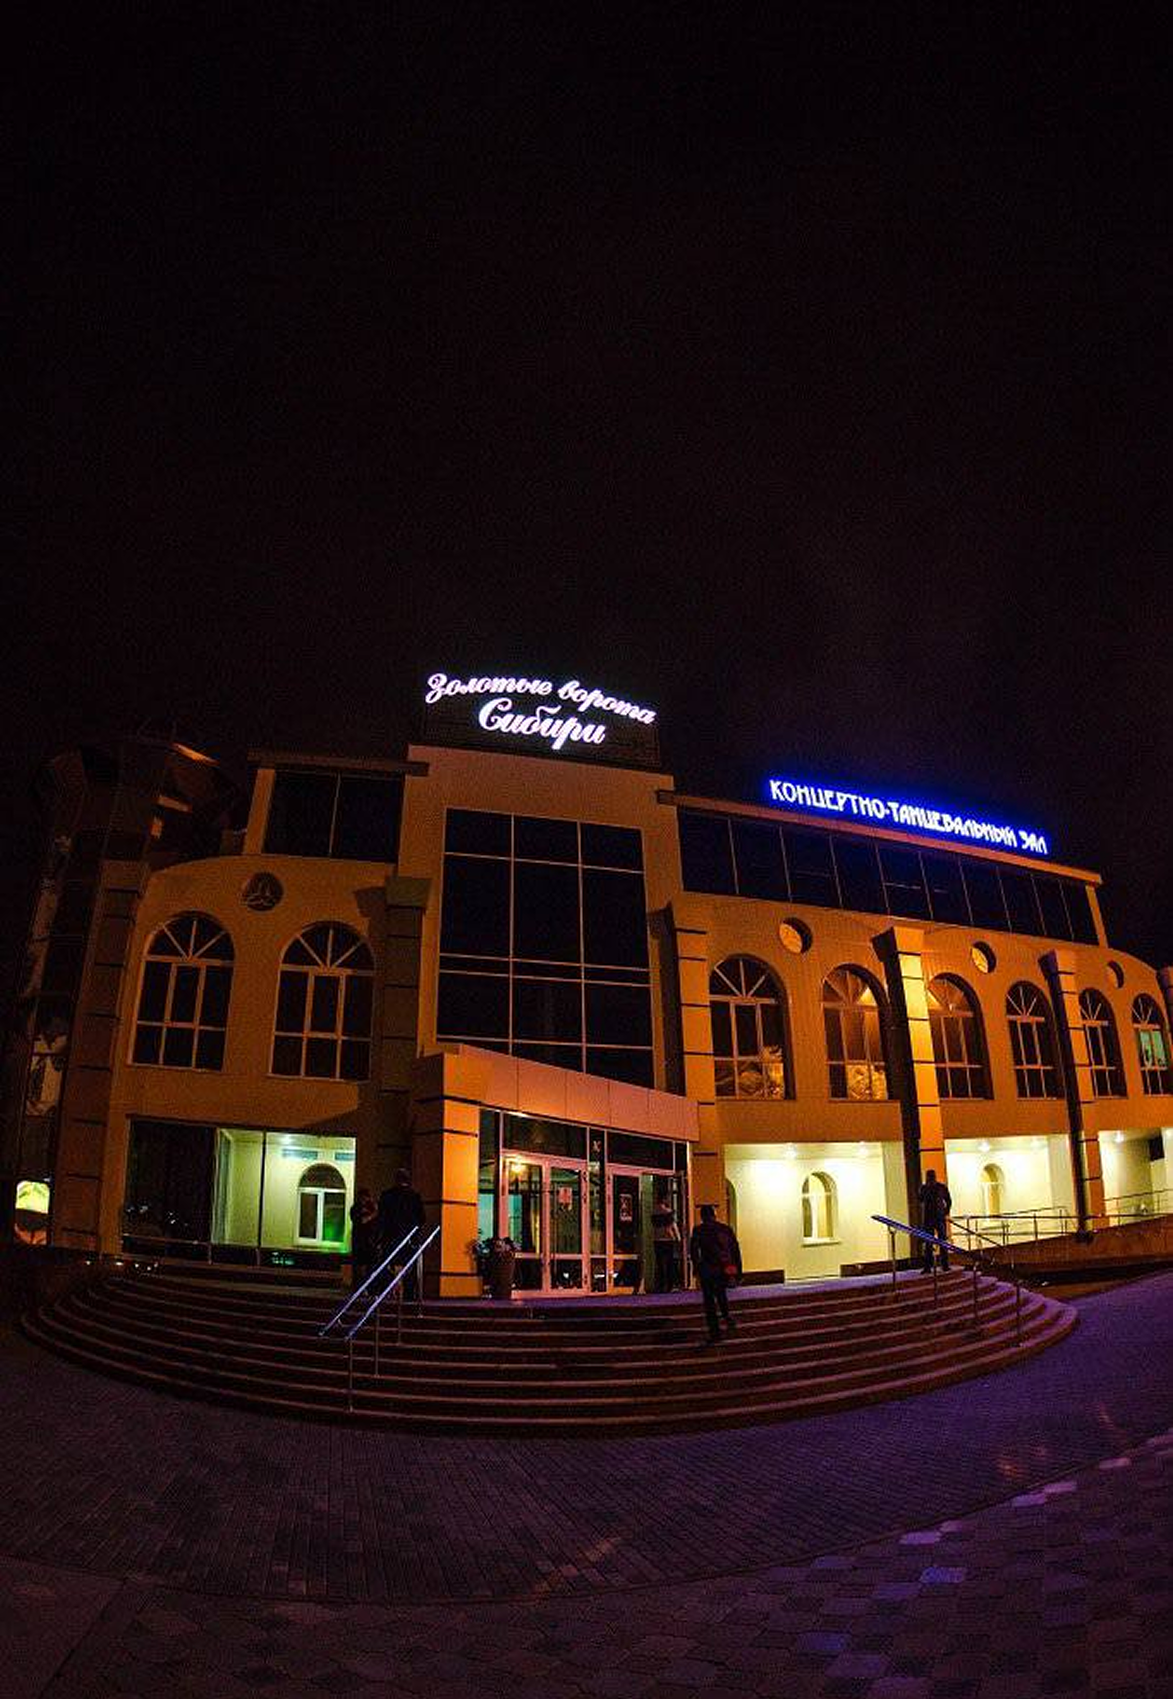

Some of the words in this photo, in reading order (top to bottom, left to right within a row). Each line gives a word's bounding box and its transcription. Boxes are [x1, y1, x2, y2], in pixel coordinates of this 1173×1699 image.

[425, 673, 553, 704] Золотые
[557, 680, 657, 725] ворота
[478, 698, 606, 750] Сибири
[769, 779, 1017, 848] КОНЦЕРТНО-ТАНЦЕВАЛЬНЫЙ
[1018, 830, 1048, 855] ЗАЛ
